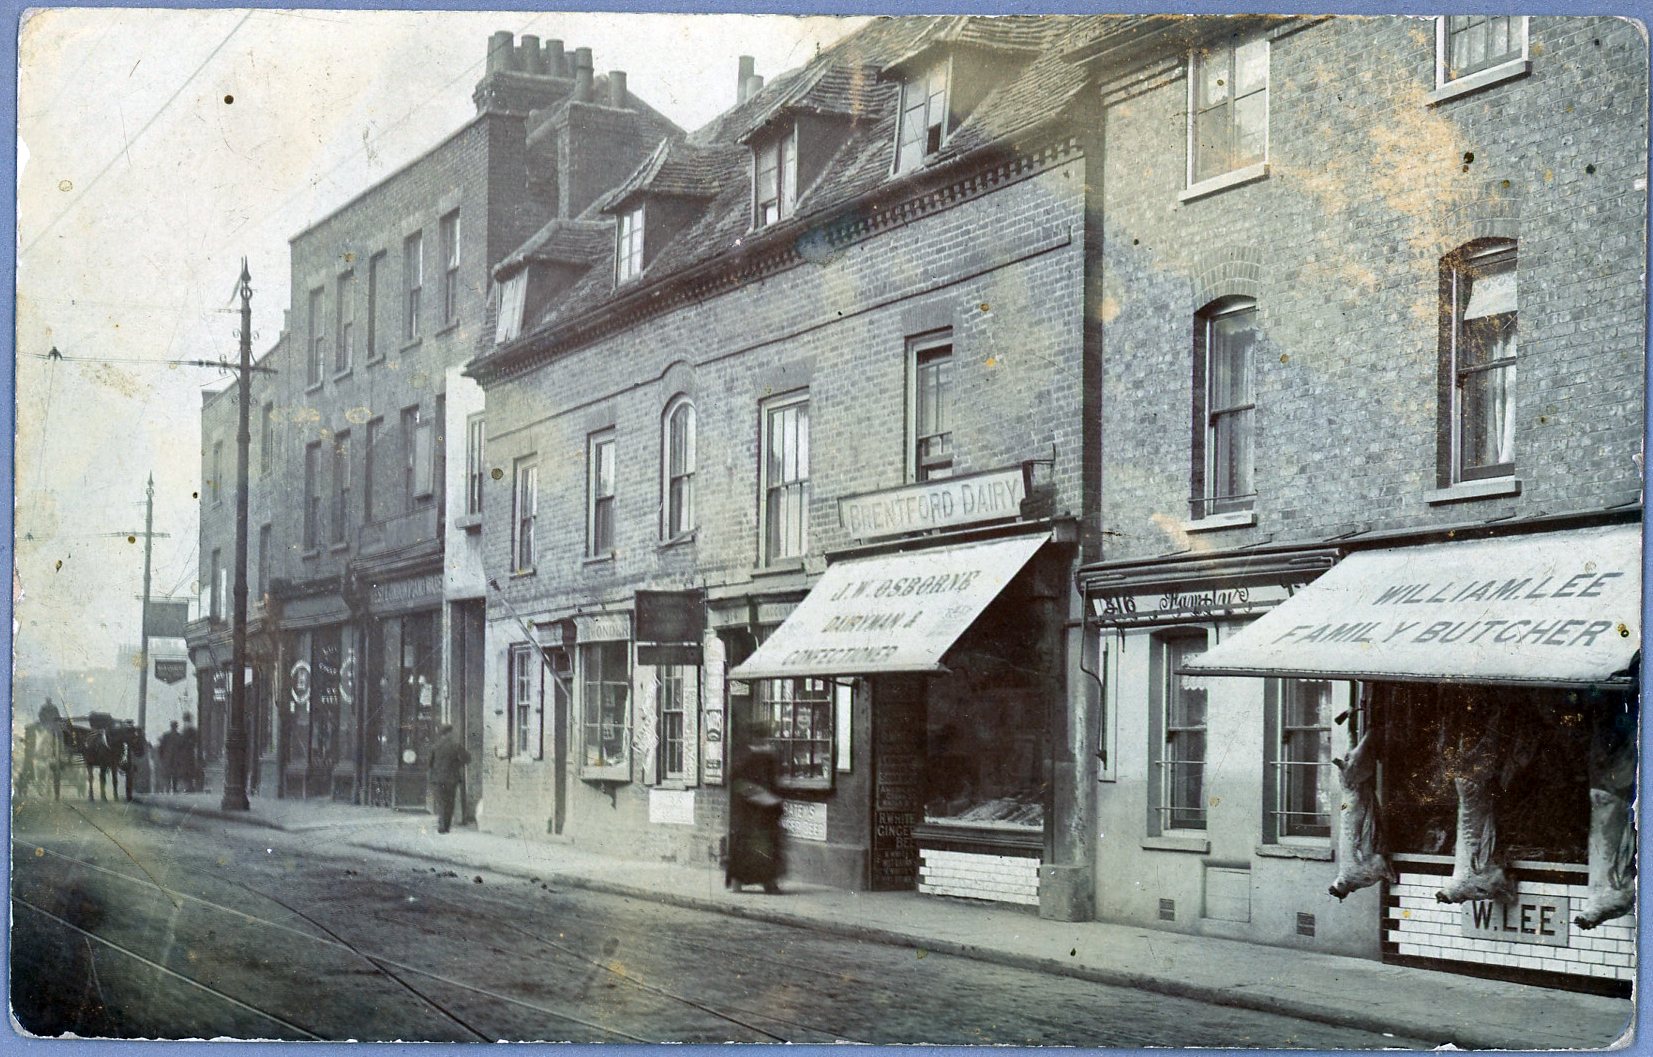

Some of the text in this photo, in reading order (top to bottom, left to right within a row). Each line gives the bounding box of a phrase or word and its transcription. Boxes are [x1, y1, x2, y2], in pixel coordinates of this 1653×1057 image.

[850, 478, 1019, 533] BRENTFORD DAIRY
[874, 570, 982, 599] OSBORNE
[821, 610, 924, 634] DAIRYMAN &
[1271, 619, 1614, 648] FAMILY BUTCHER
[781, 645, 899, 666] CONFECTIONER
